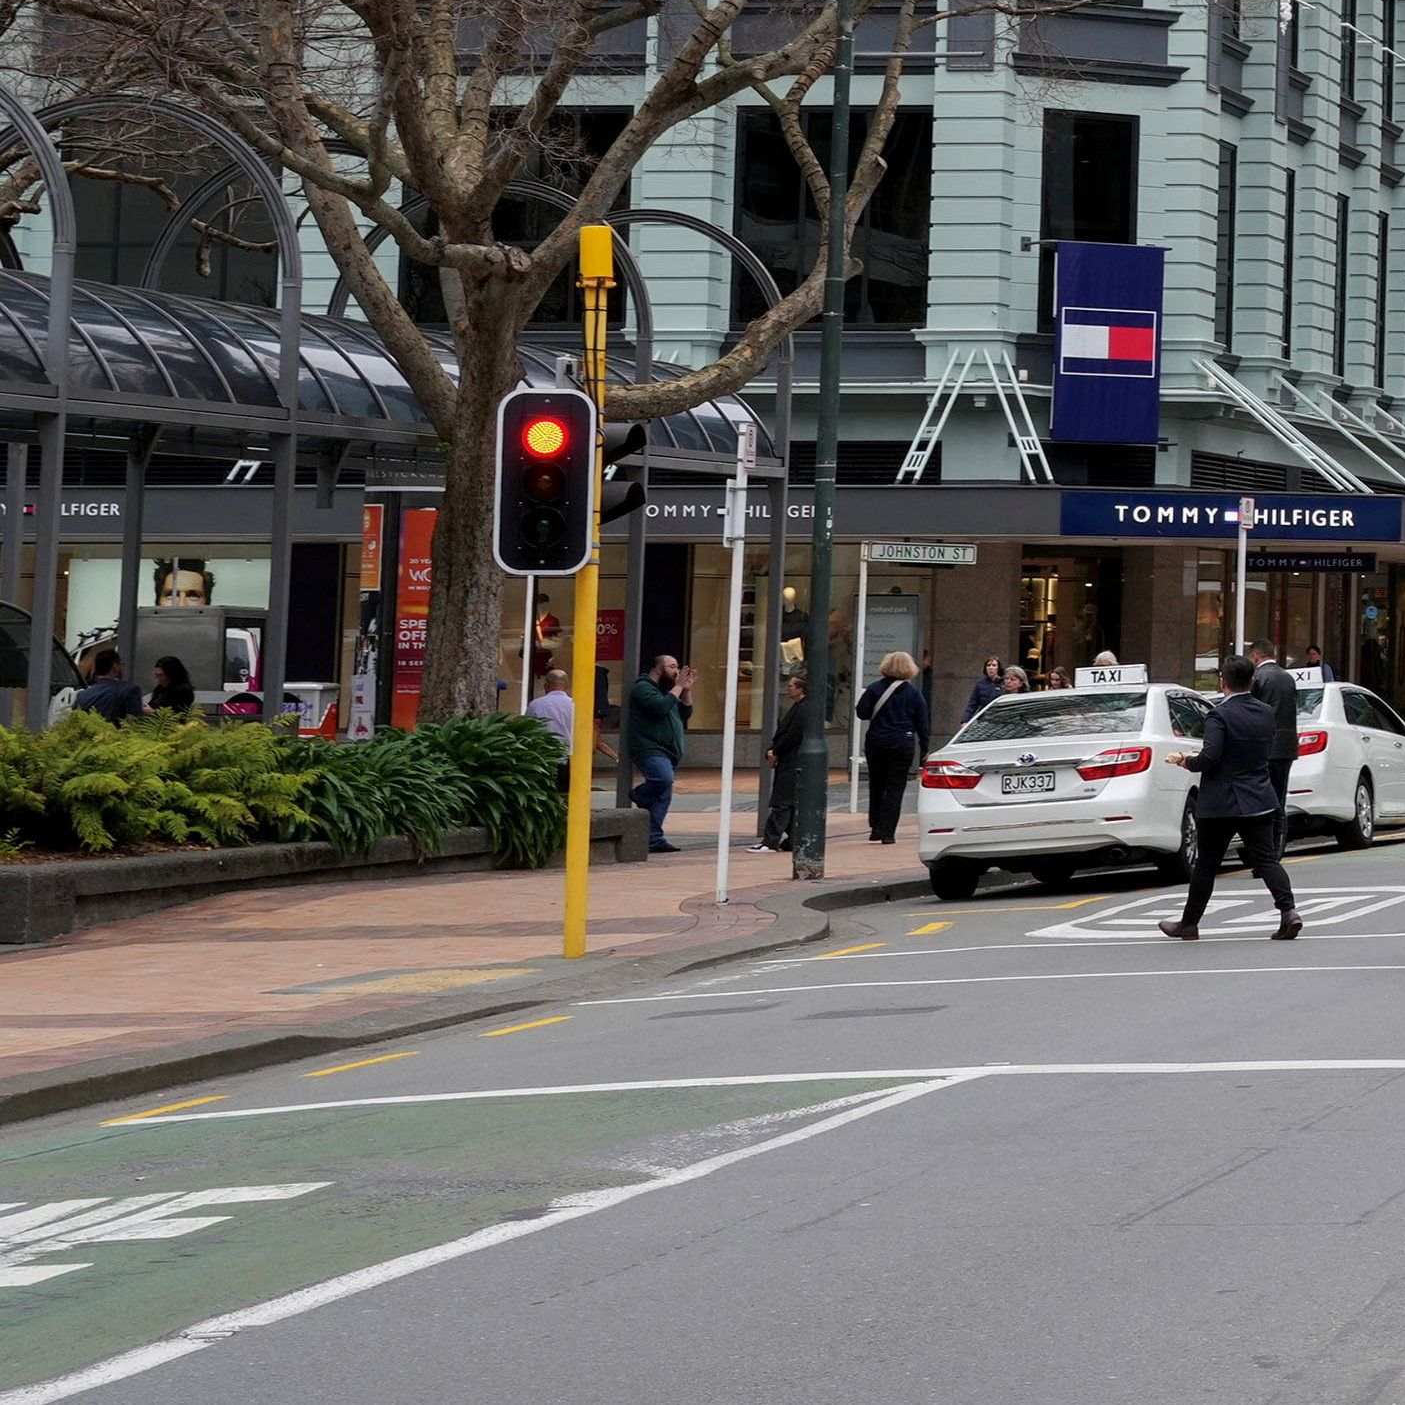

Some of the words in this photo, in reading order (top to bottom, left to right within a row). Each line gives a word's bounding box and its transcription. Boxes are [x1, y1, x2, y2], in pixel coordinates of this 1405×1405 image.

[61, 503, 120, 516] LFIGER
[646, 505, 711, 517] OMMY
[745, 505, 815, 517] HILGE
[1114, 505, 1218, 523] TOMMY
[1254, 509, 1354, 526] HILFIGER
[879, 546, 945, 558] JOHNSTON
[953, 548, 968, 559] ST
[1249, 558, 1296, 567] TOMMY
[1315, 558, 1363, 567] HILFIGER
[399, 620, 427, 629] SPE
[597, 624, 618, 635] 0%
[399, 631, 427, 640] OFF
[1091, 669, 1121, 683] TAXI
[1295, 672, 1311, 681] XI
[1004, 775, 1053, 790] RJK337
